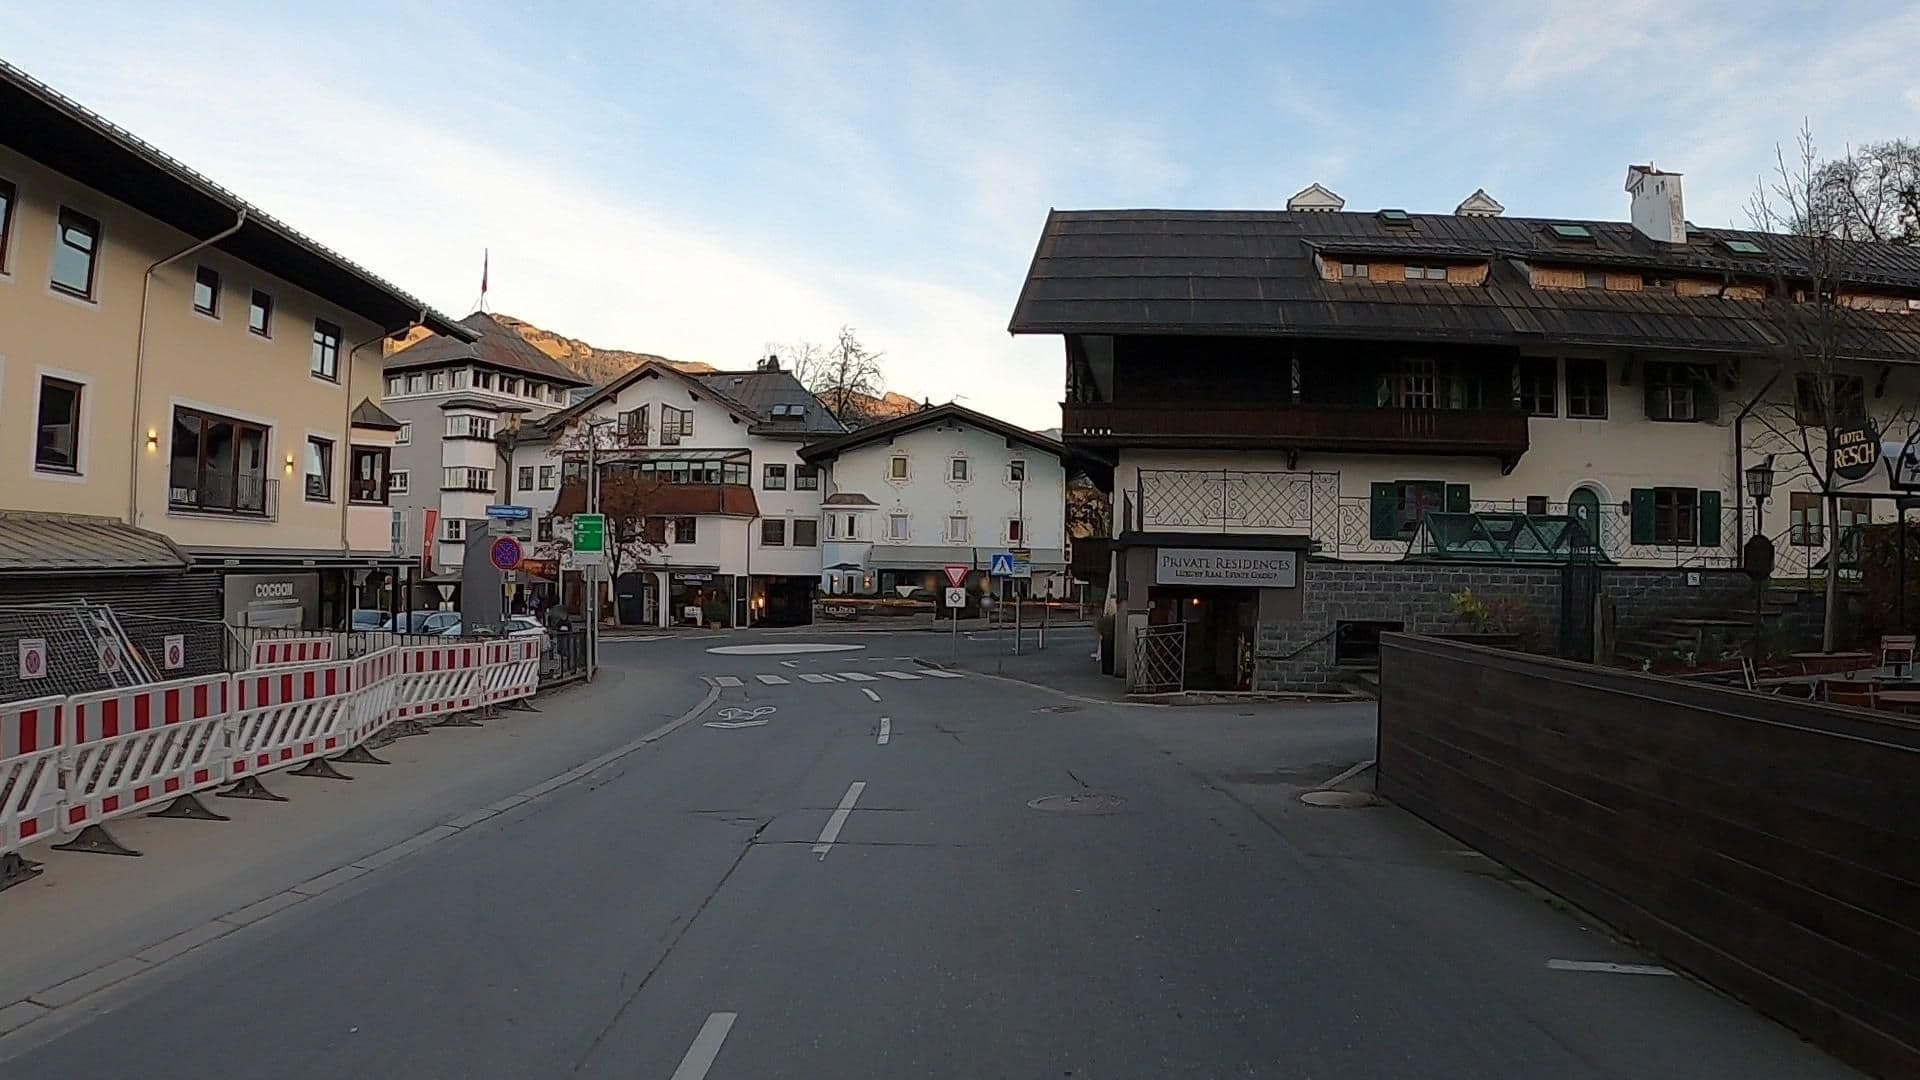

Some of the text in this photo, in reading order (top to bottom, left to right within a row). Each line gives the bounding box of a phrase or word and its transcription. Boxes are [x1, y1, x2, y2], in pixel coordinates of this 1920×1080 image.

[1840, 430, 1866, 445] HOTEL
[1834, 442, 1874, 468] RESCH
[1162, 556, 1291, 570] PRIVATE RESIDENCES
[256, 583, 293, 597] COCOON
